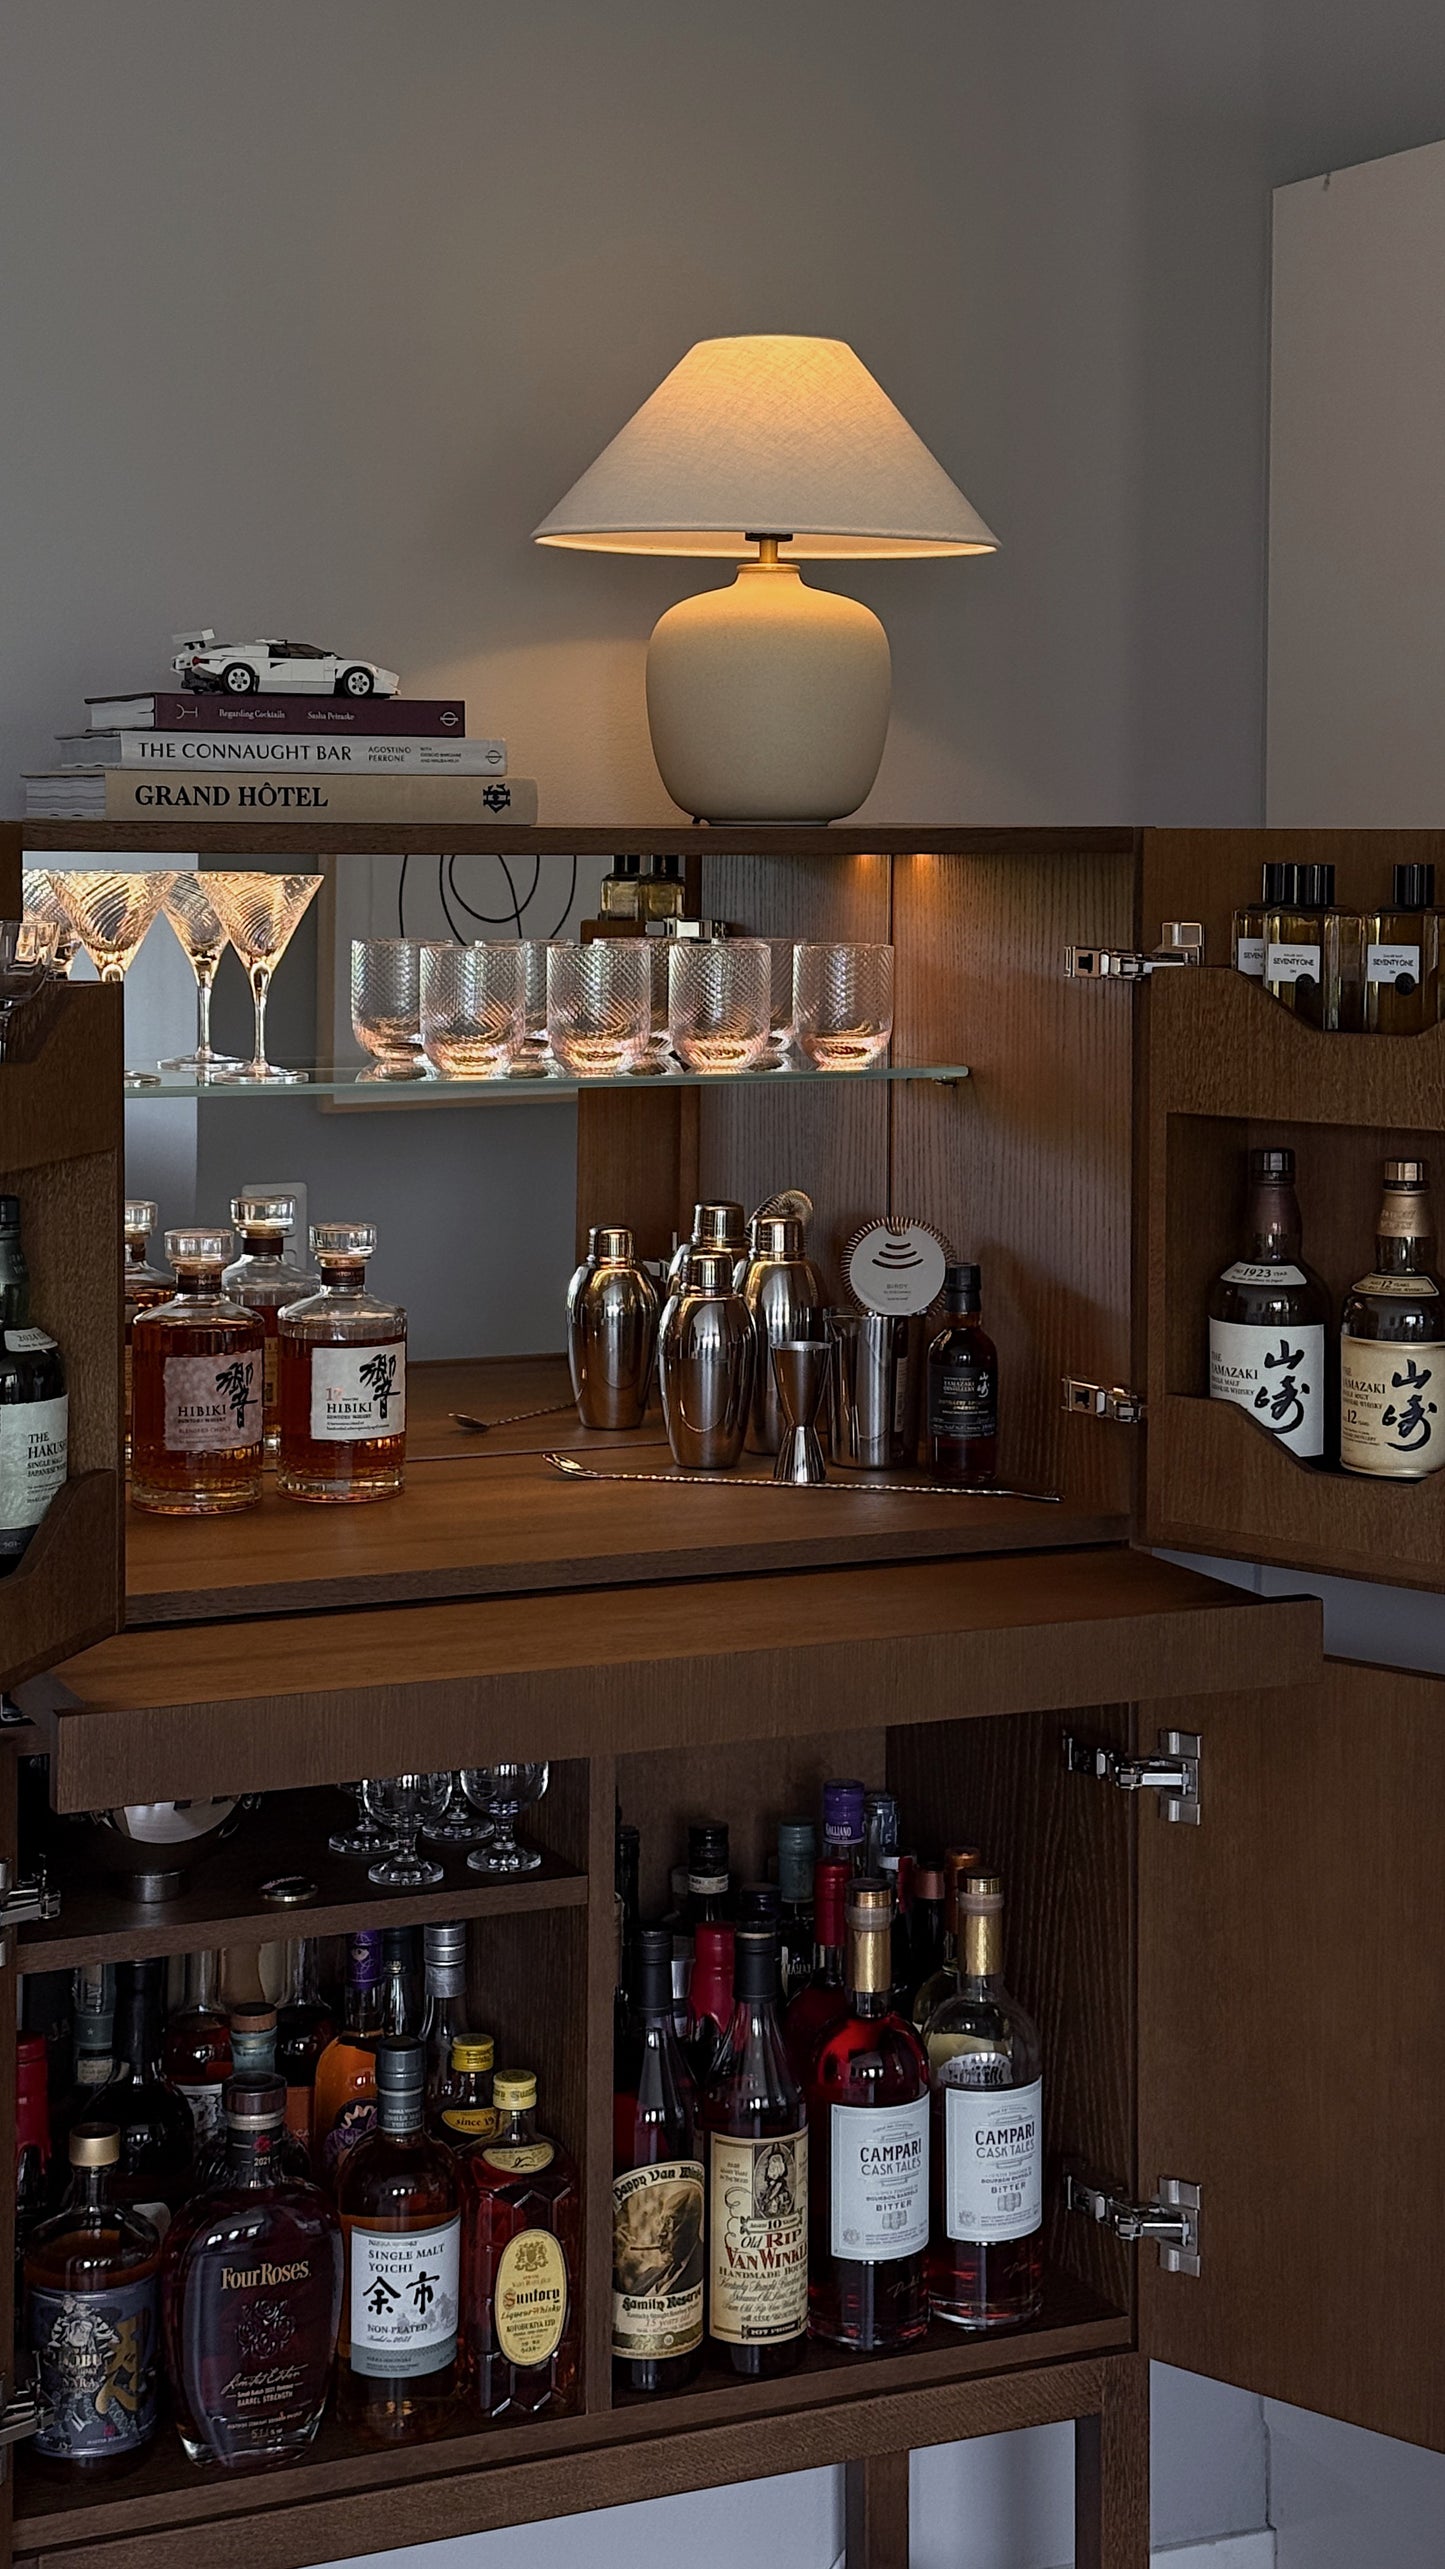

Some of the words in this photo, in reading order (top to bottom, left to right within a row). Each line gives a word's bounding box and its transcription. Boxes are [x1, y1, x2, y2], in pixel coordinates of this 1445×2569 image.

[219, 708, 254, 720] Regarding
[254, 709, 286, 719] Cocktails
[307, 711, 326, 720] Sasha
[138, 742, 176, 758] THE
[182, 743, 310, 760] CONNAUGHT
[317, 745, 352, 761] BAR
[367, 746, 412, 754] AGOSTINO
[368, 754, 405, 762] PERRONE
[135, 784, 231, 807] GRAND
[237, 782, 329, 807] HÔTEL
[1273, 957, 1300, 966] SEVENTY
[1300, 959, 1315, 967] ONE
[1372, 958, 1399, 967] SEVENTY
[1400, 959, 1414, 967] ONE
[1243, 1267, 1272, 1278] 1923
[1381, 1280, 1392, 1289] 12
[1254, 1339, 1310, 1434] 山崎
[178, 1404, 226, 1418] HIBIKI
[326, 1402, 373, 1414] HIBIKI
[1382, 1359, 1438, 1452] 山崎
[1347, 1408, 1357, 1425] 12
[28, 1431, 50, 1444] THE
[824, 1821, 852, 1838] GALLIANO
[456, 2118, 481, 2127] since
[975, 2121, 1035, 2146] CAMPARI
[860, 2138, 922, 2162] CAMPARI
[976, 2146, 1008, 2159] CASK
[1010, 2139, 1035, 2156] TALES
[254, 2156, 271, 2166] 2021
[861, 2163, 893, 2176] CASK
[895, 2156, 921, 2173] TALES
[613, 2174, 647, 2201] Pappy
[647, 2169, 676, 2182] Van
[991, 2181, 1026, 2194] BITTER
[876, 2200, 912, 2212] BITTER
[768, 2219, 782, 2230] 10
[741, 2236, 763, 2249] Old
[765, 2229, 802, 2249] RIP
[368, 2249, 413, 2261] SINGLE
[416, 2244, 445, 2260] MALT
[725, 2246, 758, 2270] VAN
[220, 2266, 261, 2291] Four
[259, 2259, 310, 2286] Roses
[369, 2262, 413, 2273] YOICHI
[719, 2266, 781, 2279] HANDMADE
[363, 2271, 440, 2315] 余市
[503, 2288, 560, 2309] Suntory
[622, 2296, 665, 2312] Family
[390, 2322, 428, 2335] PEATED
[237, 2396, 261, 2408] BARREL
[262, 2390, 294, 2404] STRENGTH
